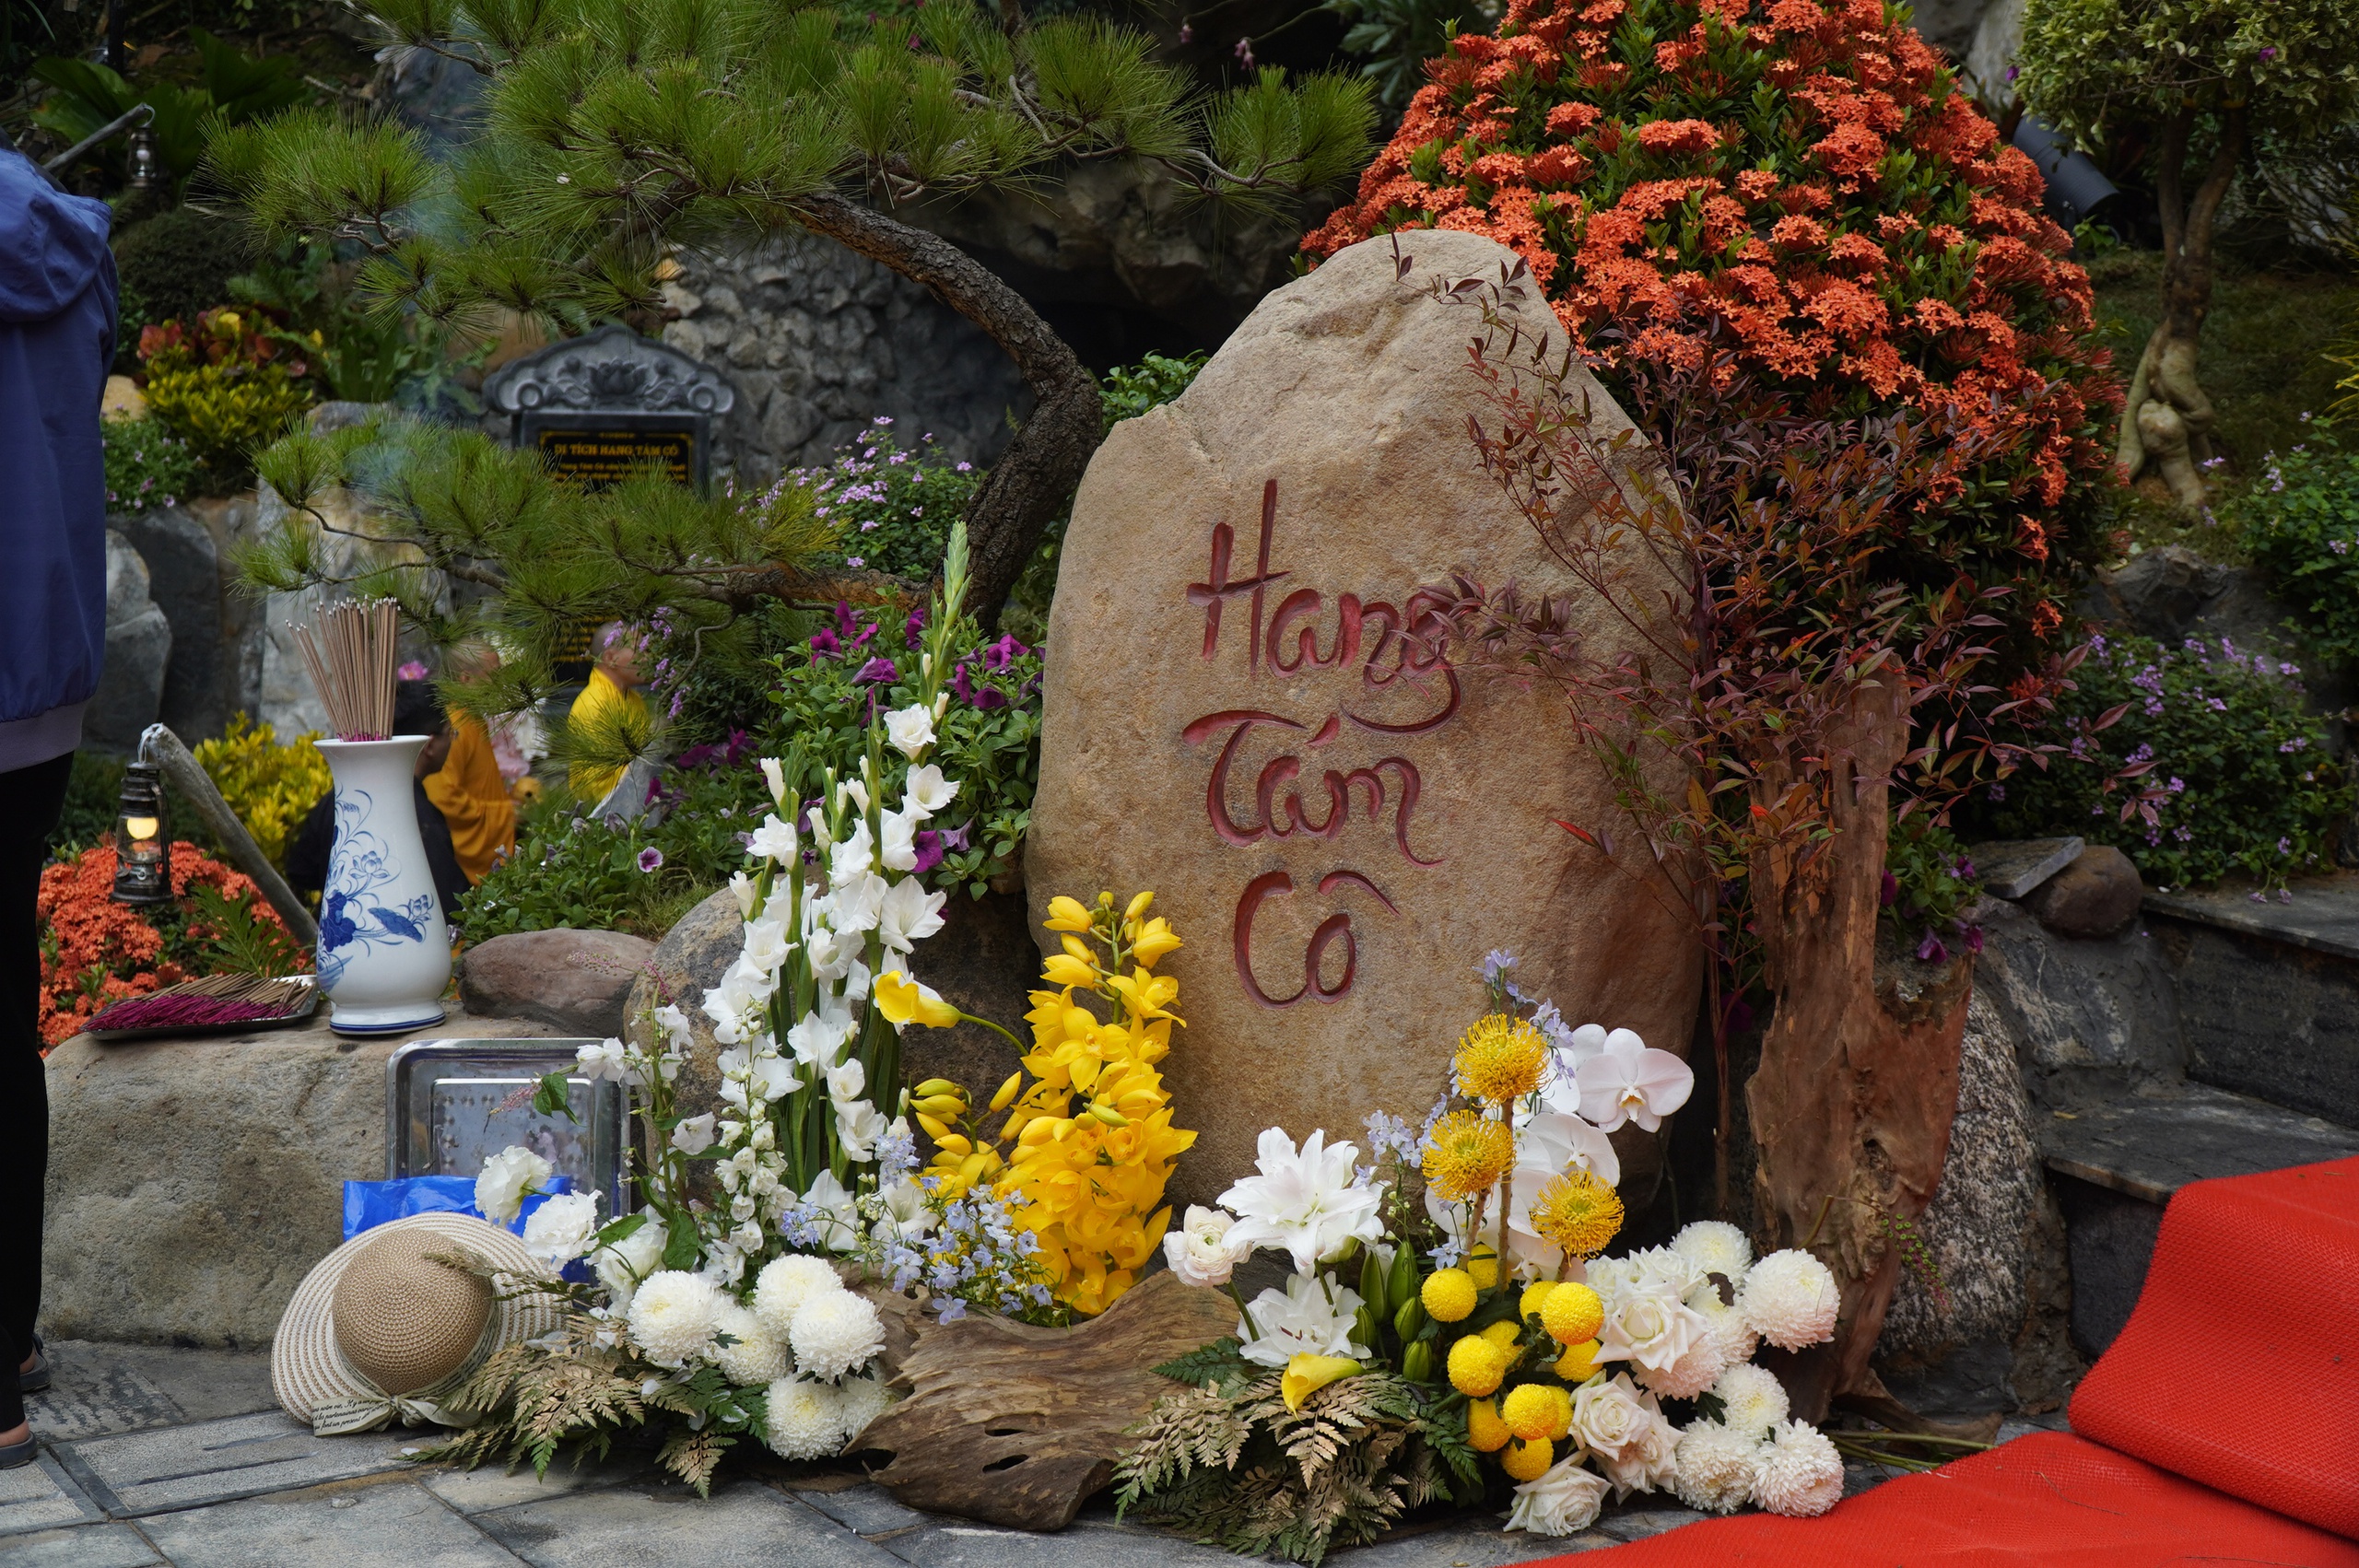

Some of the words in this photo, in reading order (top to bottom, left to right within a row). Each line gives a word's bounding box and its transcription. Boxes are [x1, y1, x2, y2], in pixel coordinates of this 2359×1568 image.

[570, 441, 598, 455] TÍCH
[600, 443, 634, 456] HANG
[1186, 478, 1462, 735] Hang
[1182, 708, 1448, 869] Tám
[1234, 870, 1402, 1010] Cô
